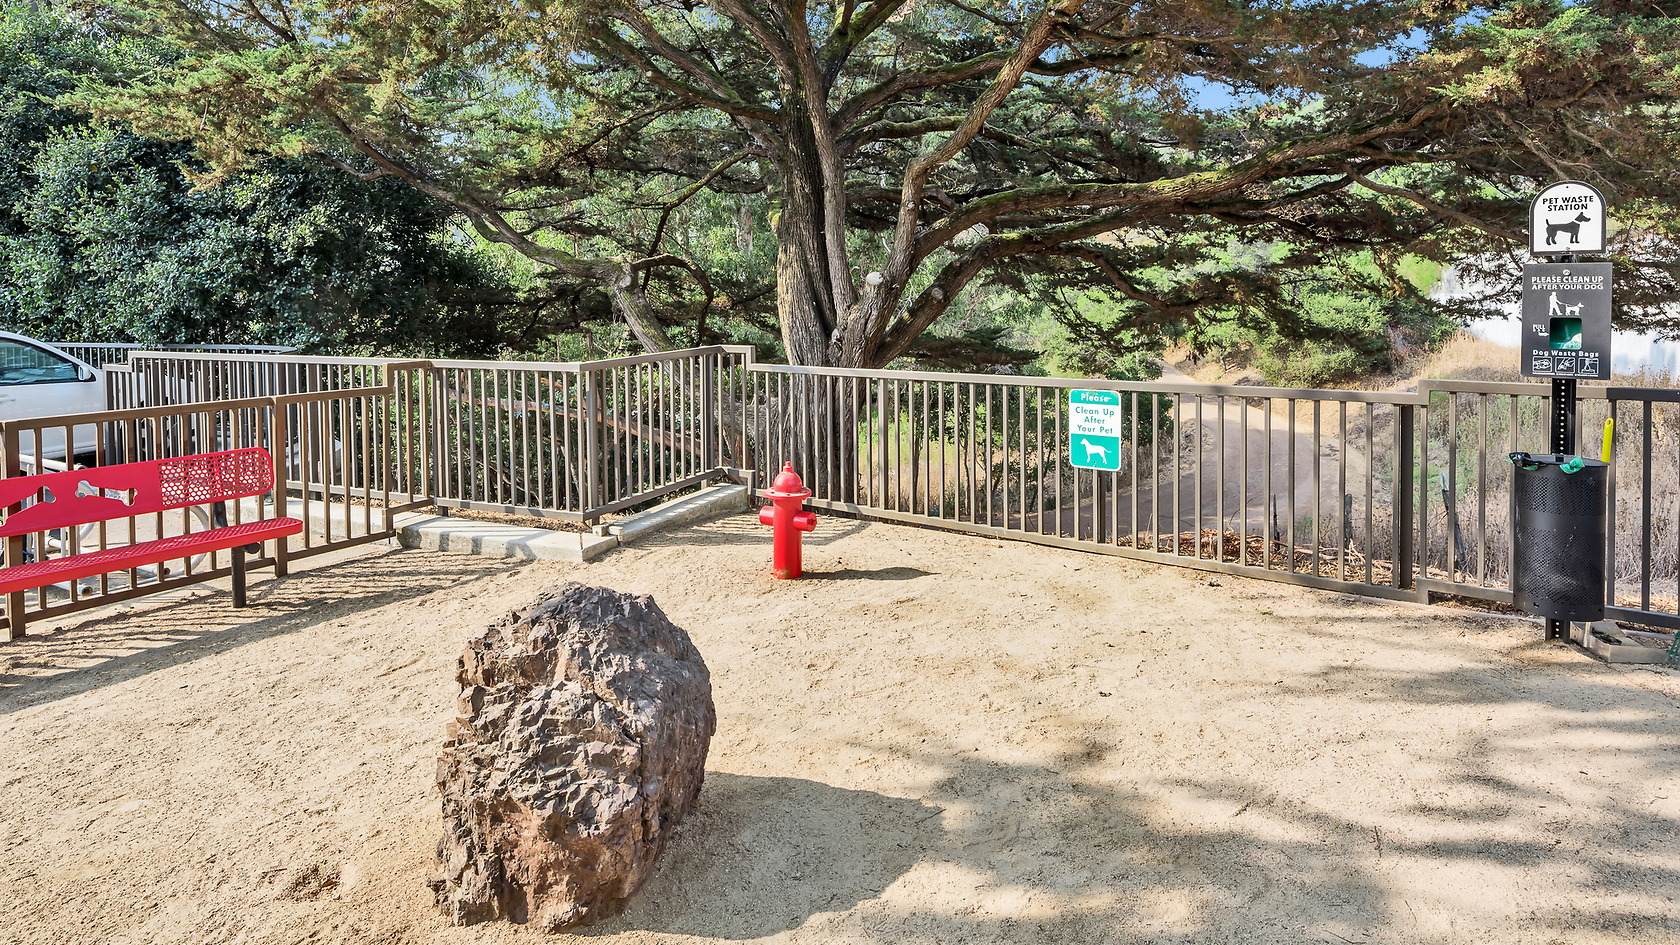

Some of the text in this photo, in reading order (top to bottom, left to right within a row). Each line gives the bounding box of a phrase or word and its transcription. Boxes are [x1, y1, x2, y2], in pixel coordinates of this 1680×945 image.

[1542, 195, 1594, 205] PET WASTE
[1547, 203, 1588, 212] STATION
[1532, 349, 1549, 357] Dog
[1578, 350, 1599, 358] Bags
[1081, 392, 1109, 403] Please
[1075, 406, 1115, 418] Clean Up
[1084, 416, 1105, 425] After
[1077, 424, 1113, 434] Your Pet
